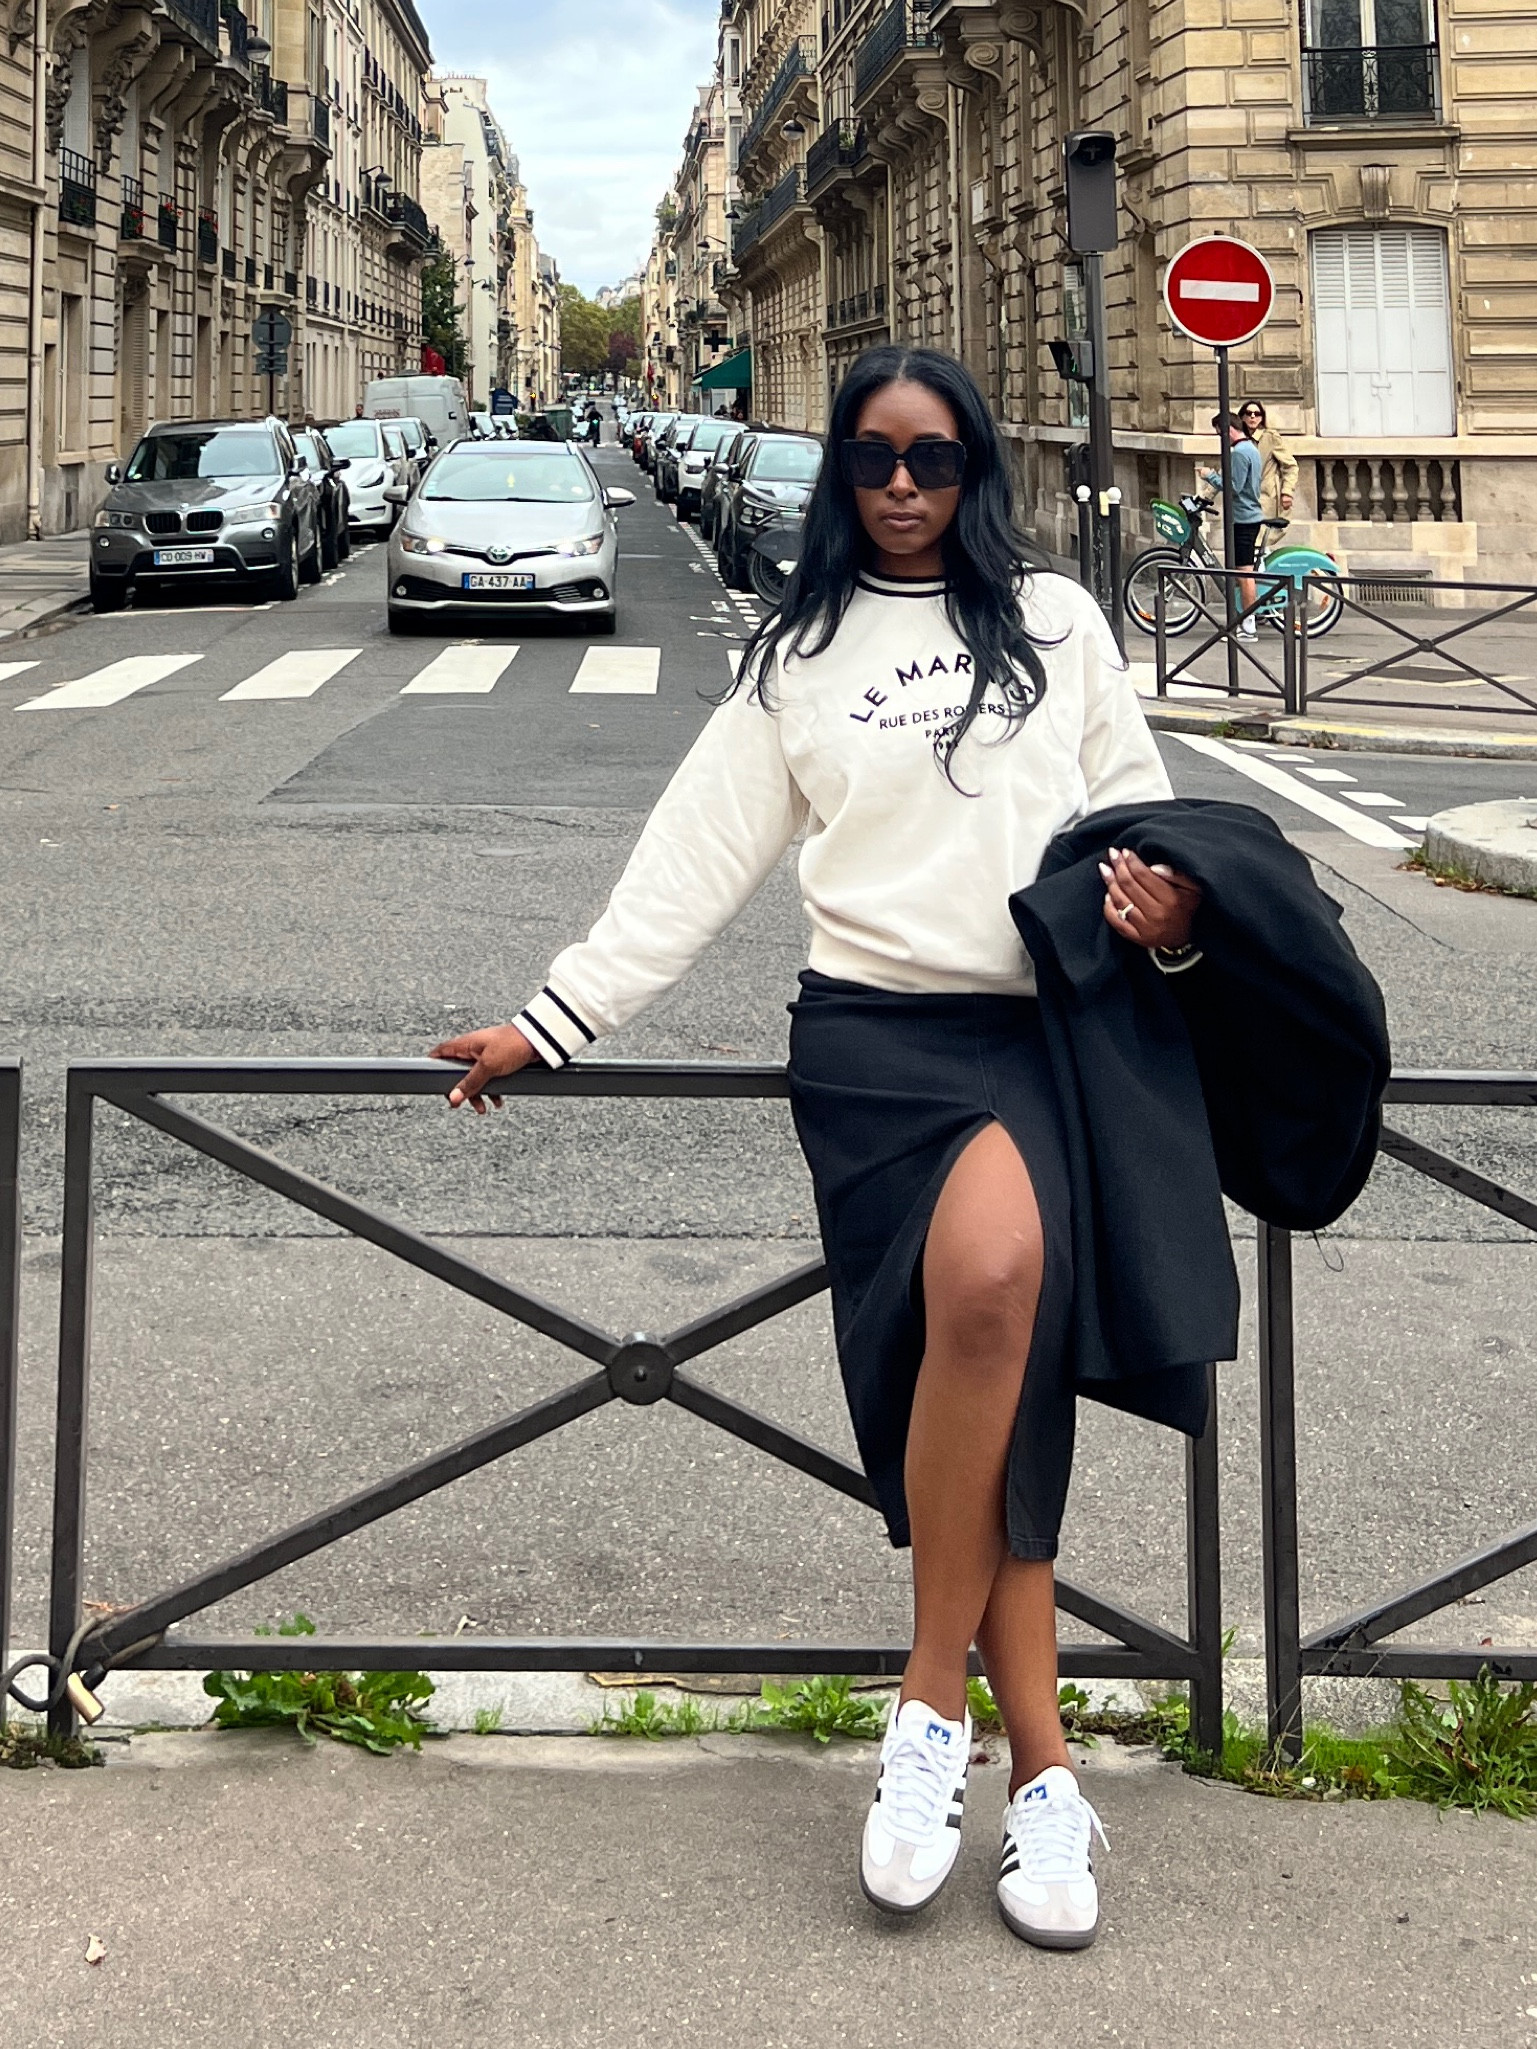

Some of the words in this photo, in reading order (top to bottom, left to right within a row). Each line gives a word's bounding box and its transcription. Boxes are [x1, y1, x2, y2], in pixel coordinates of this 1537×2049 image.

[850, 687, 888, 722] LE
[895, 653, 1034, 701] MARIS
[879, 715, 907, 730] RUE
[912, 709, 940, 724] DES
[945, 703, 1005, 718] ROERS
